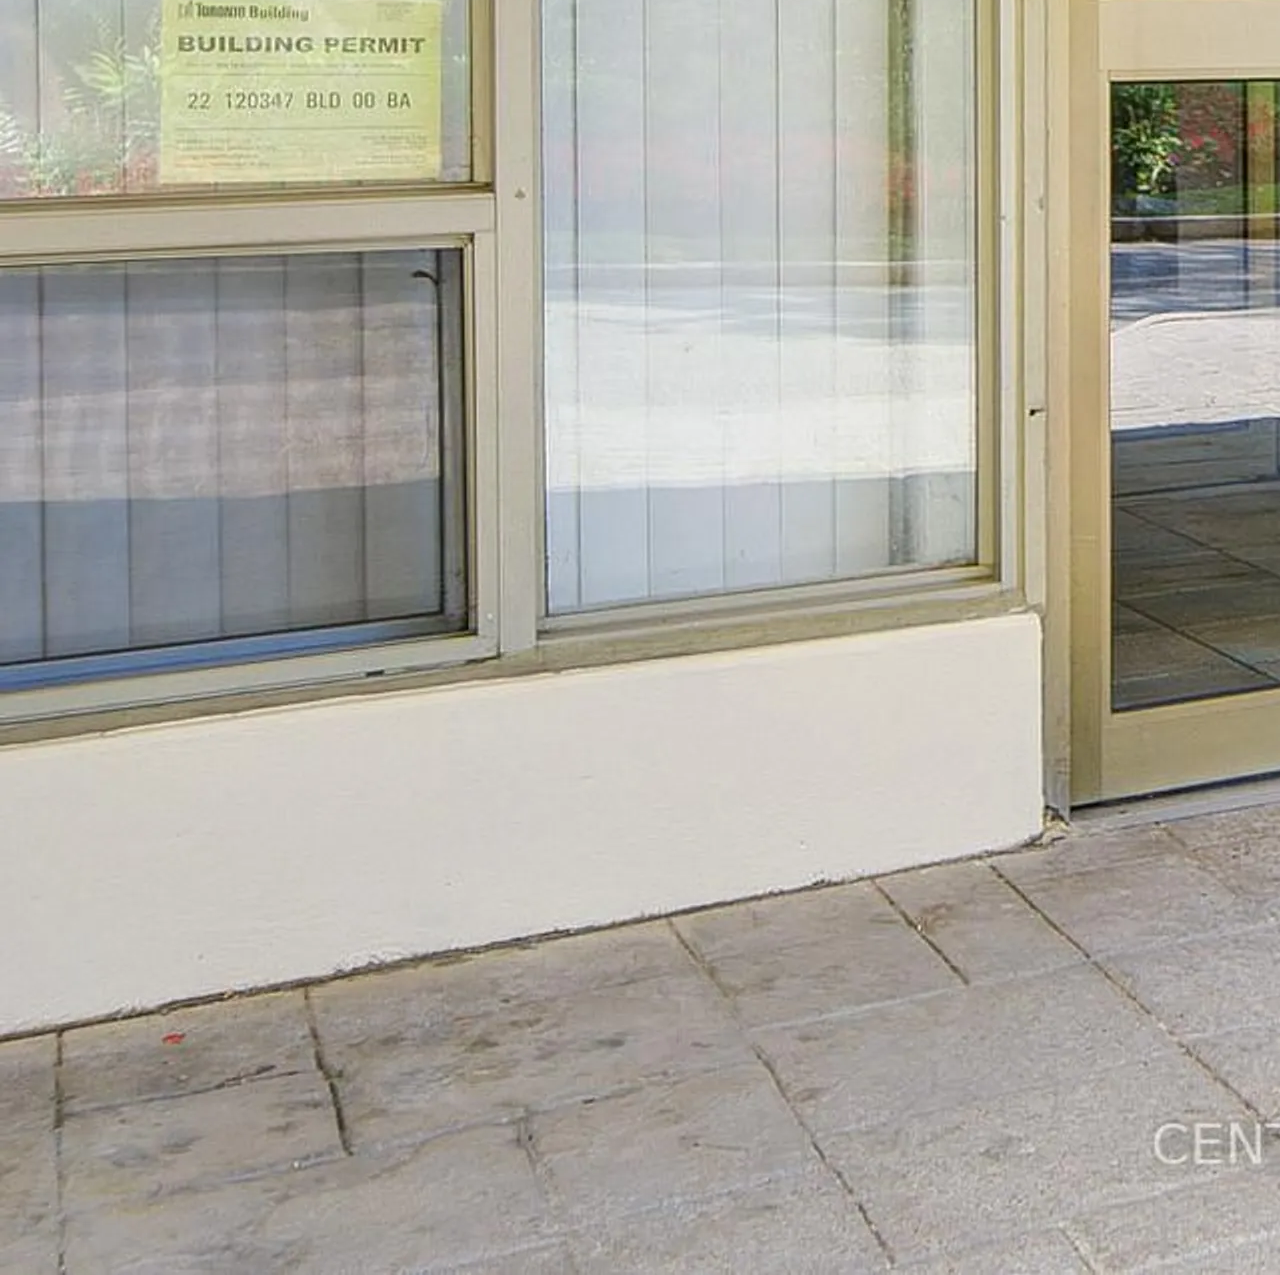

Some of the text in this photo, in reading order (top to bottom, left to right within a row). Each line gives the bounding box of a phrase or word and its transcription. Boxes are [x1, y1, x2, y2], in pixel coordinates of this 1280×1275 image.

[249, 5, 309, 22] Building
[178, 36, 426, 53] BUILDING PERMIT
[187, 91, 412, 110] 22 120347 BLD 00 BA
